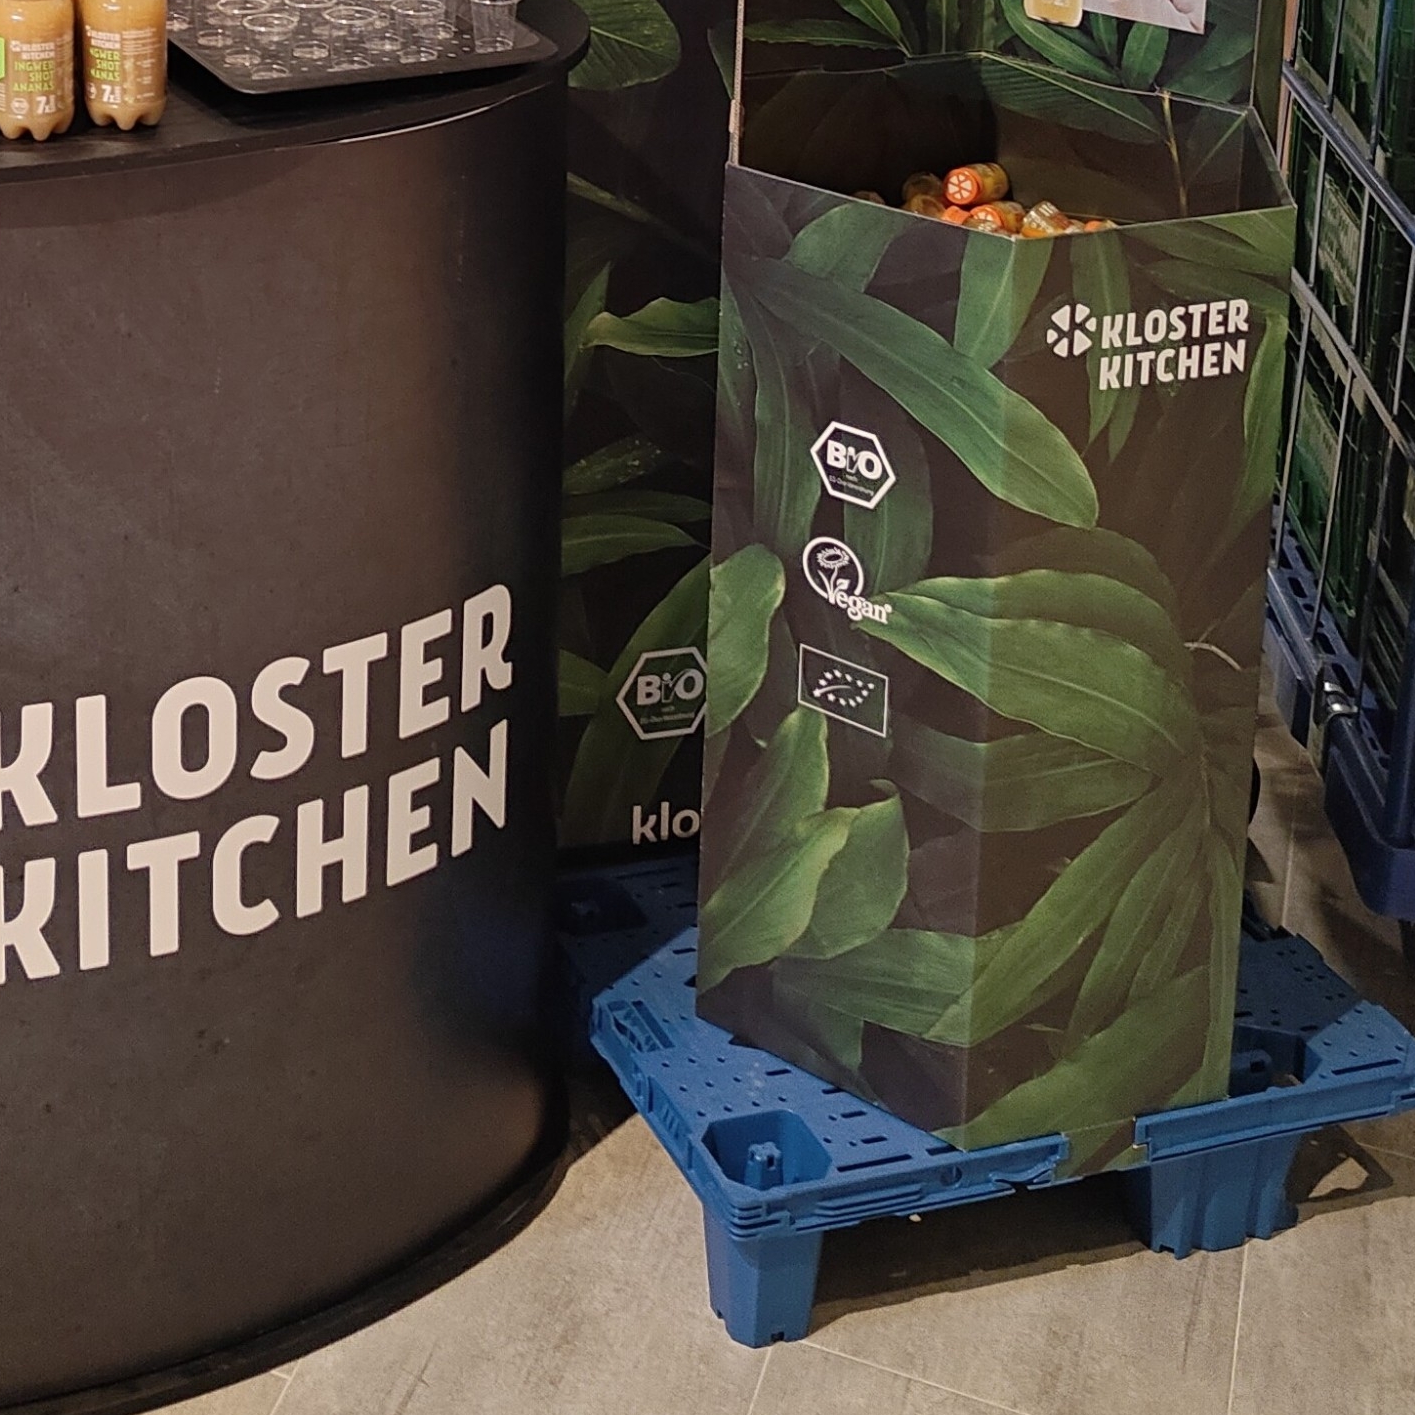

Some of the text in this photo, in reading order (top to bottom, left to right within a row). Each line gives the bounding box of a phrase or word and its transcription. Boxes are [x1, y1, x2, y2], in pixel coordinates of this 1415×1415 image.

[13, 82, 54, 92] ANANAS
[14, 61, 54, 72] INGWER
[29, 71, 54, 82] SHOT
[1100, 298, 1251, 350] KLOSTER
[1099, 338, 1248, 391] KITCHEN
[826, 439, 883, 480] BIO
[823, 578, 889, 625] Vegan
[636, 668, 704, 706] BIO
[632, 801, 701, 845] klo
